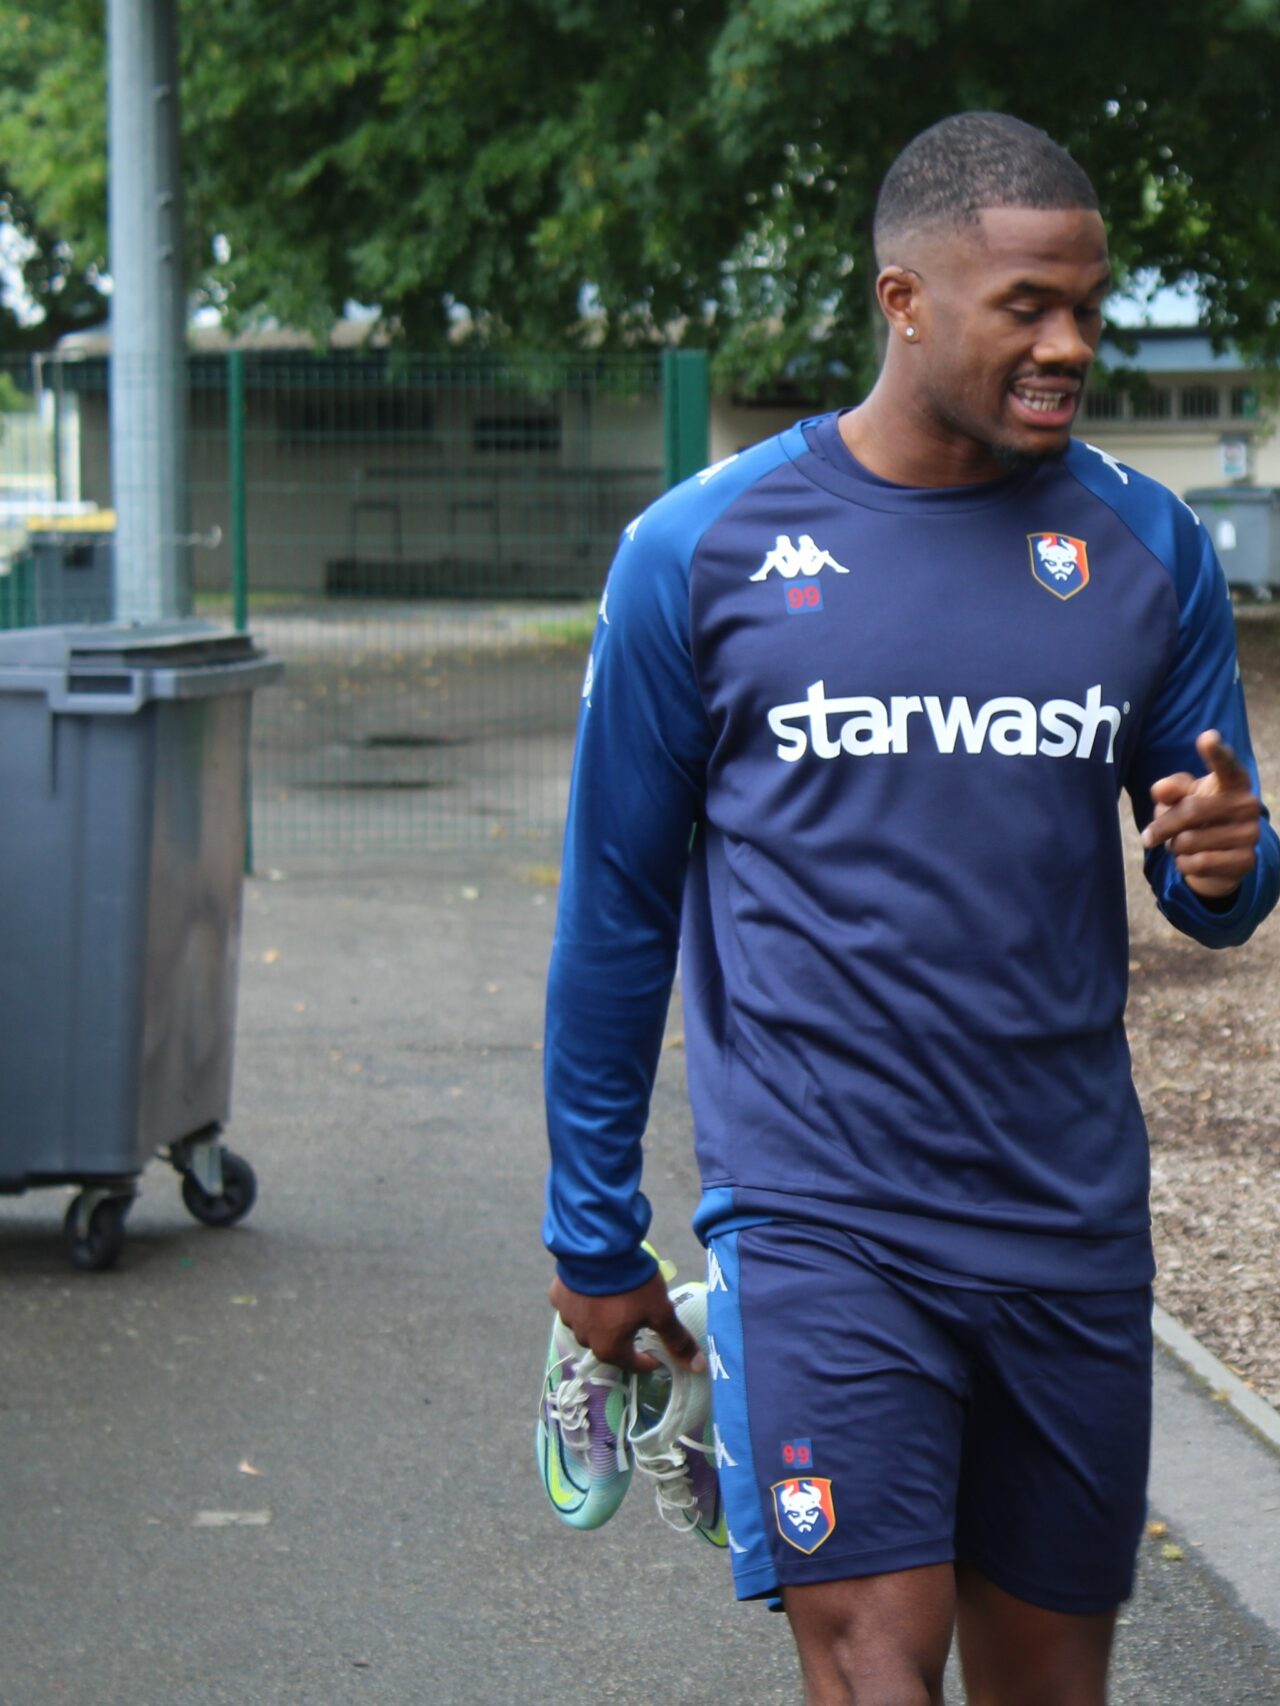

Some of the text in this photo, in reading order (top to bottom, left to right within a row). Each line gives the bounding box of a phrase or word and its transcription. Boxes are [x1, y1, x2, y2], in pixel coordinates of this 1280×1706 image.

[786, 585, 820, 609] 99
[767, 680, 1122, 764] starwash
[783, 1445, 810, 1464] 99
